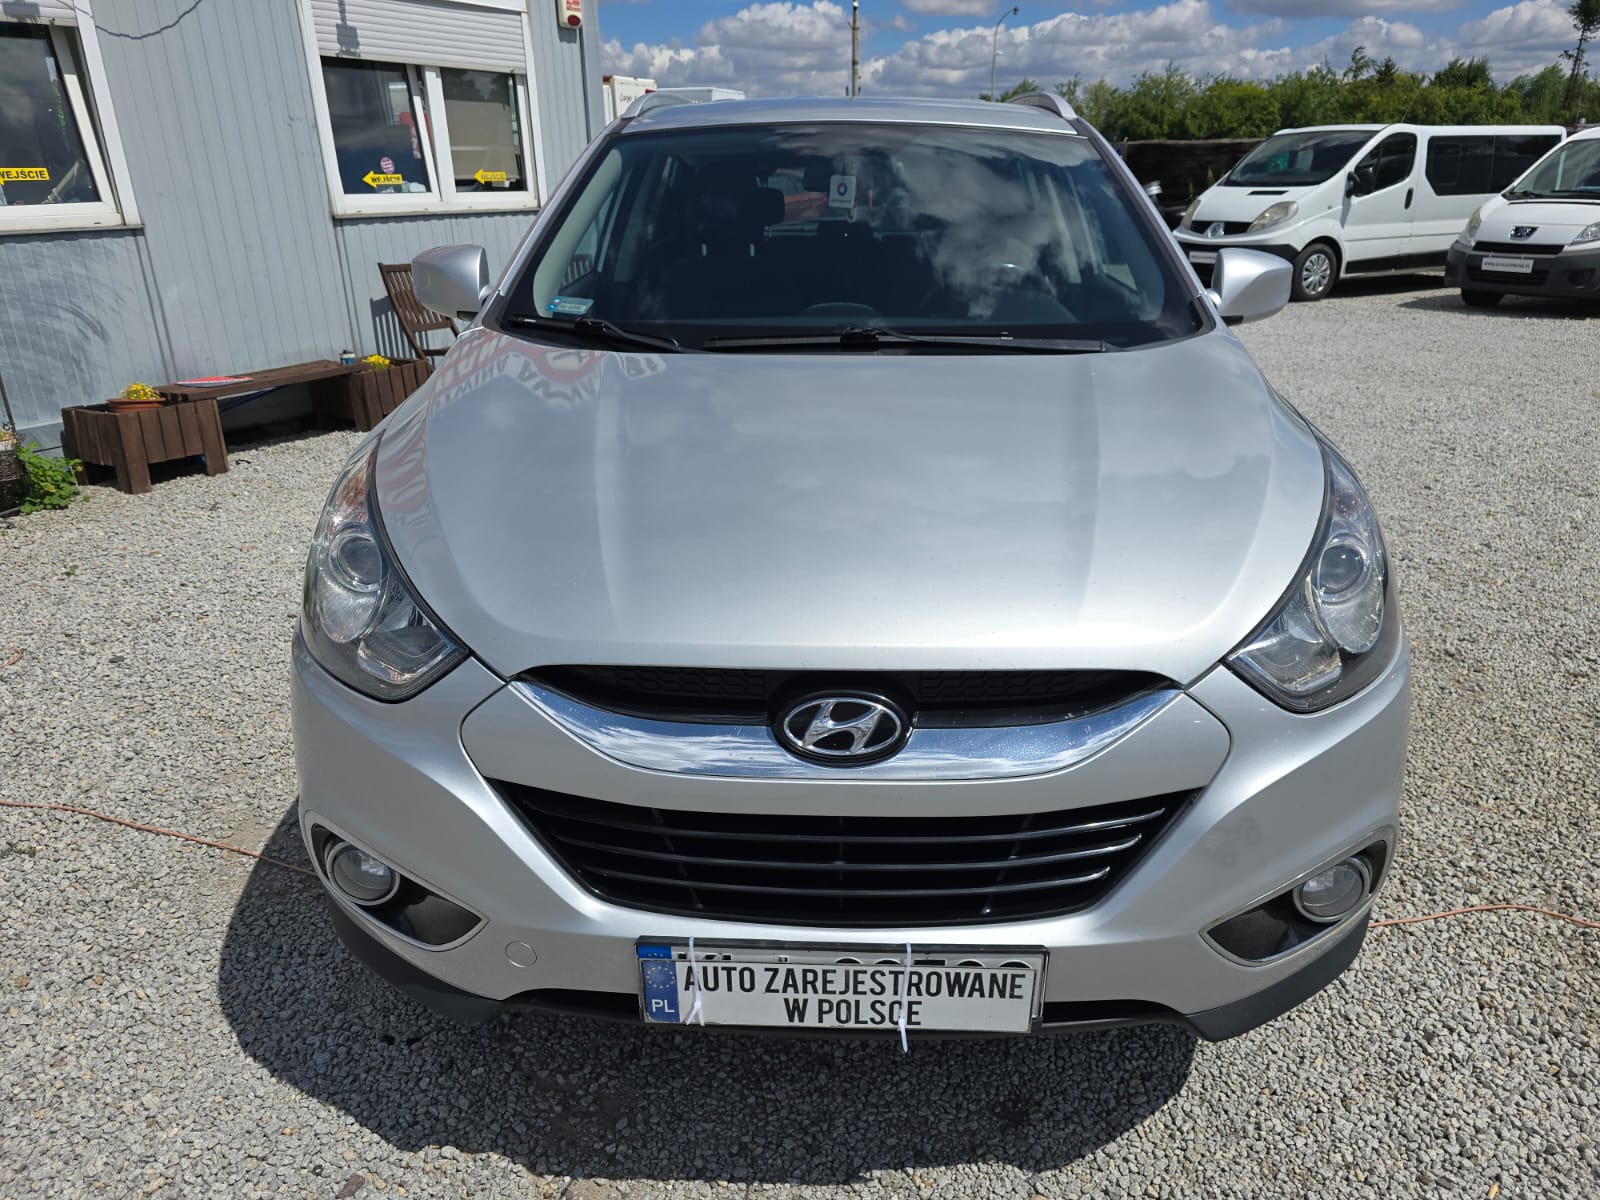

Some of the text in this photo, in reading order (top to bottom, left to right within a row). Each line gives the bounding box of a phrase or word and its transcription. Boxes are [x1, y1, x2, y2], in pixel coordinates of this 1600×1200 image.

[684, 965, 1026, 1000] AUTO ZAREJESTROWANE
[651, 999, 675, 1013] PL
[783, 998, 922, 1026] W POLSCE
